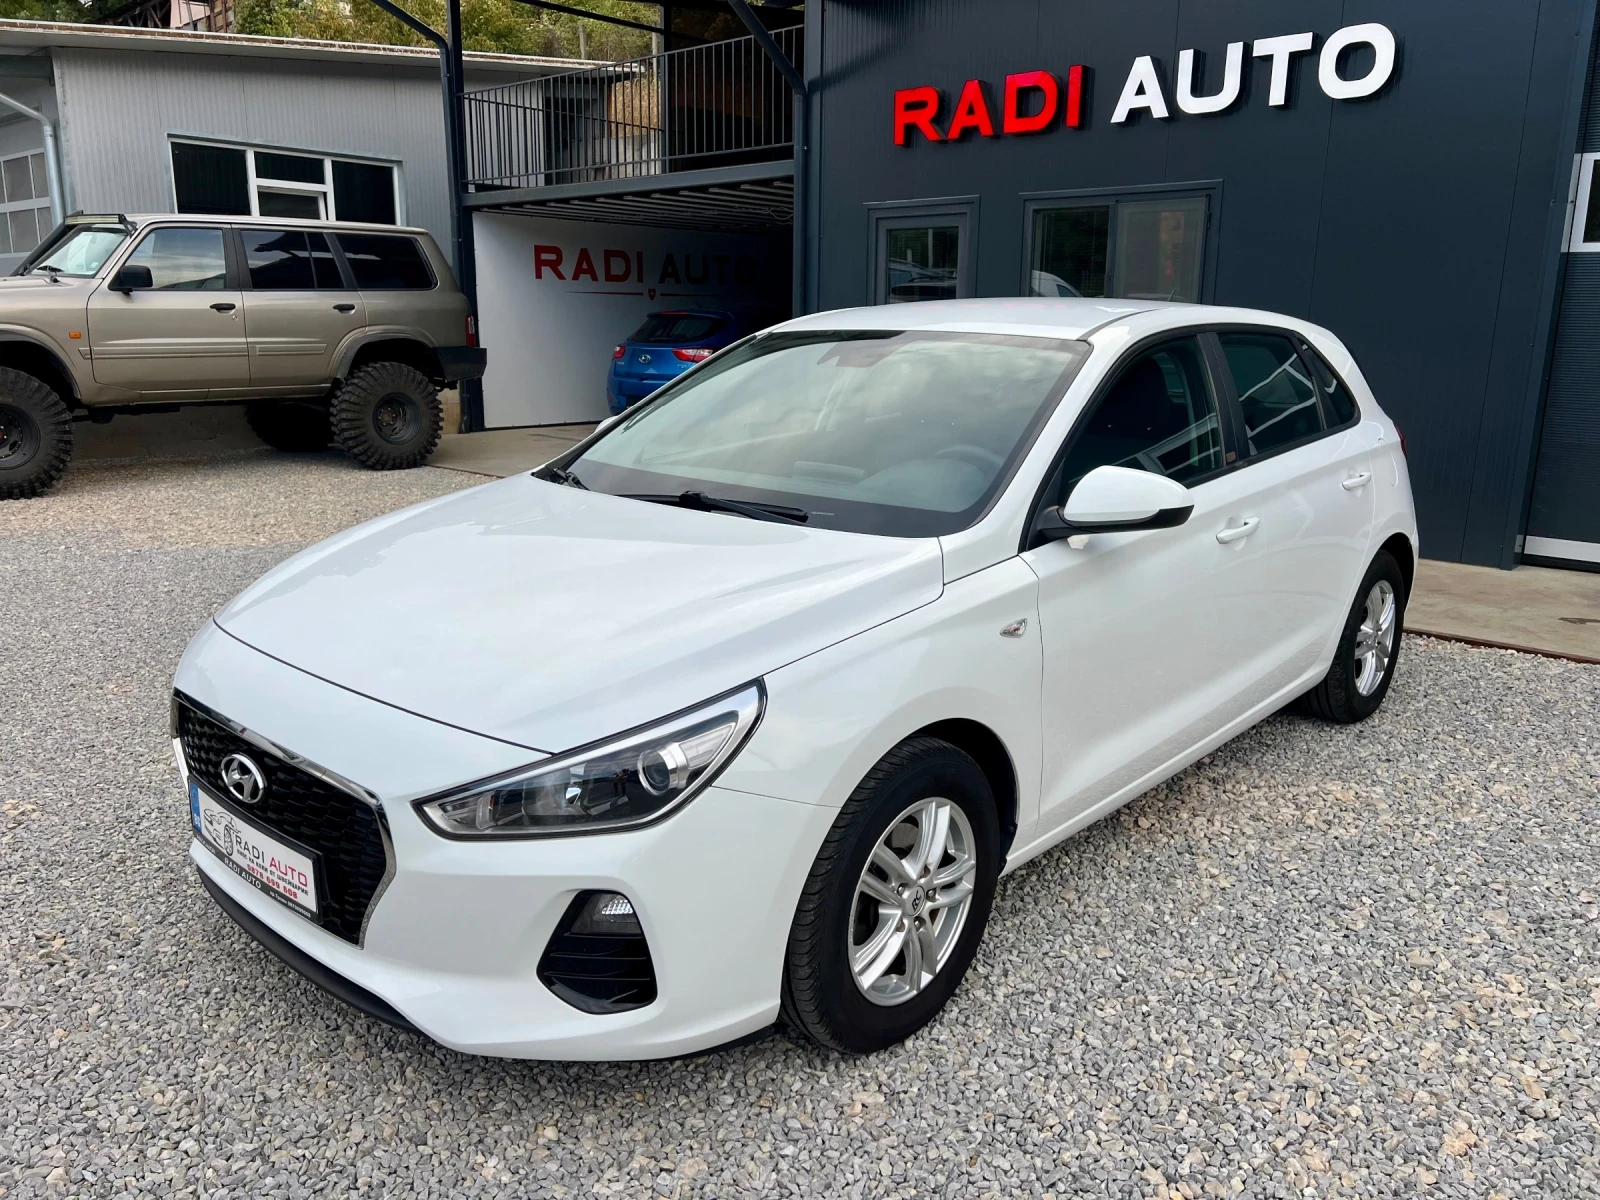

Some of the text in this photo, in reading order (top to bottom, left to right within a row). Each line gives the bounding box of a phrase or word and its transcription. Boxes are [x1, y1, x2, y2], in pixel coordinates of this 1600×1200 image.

[894, 22, 1397, 146] RADI AUTO
[533, 244, 757, 287] RADI AUTO
[224, 857, 262, 889] RADI AUTO
[235, 835, 265, 863] RADI
[269, 857, 308, 888] AUTO
